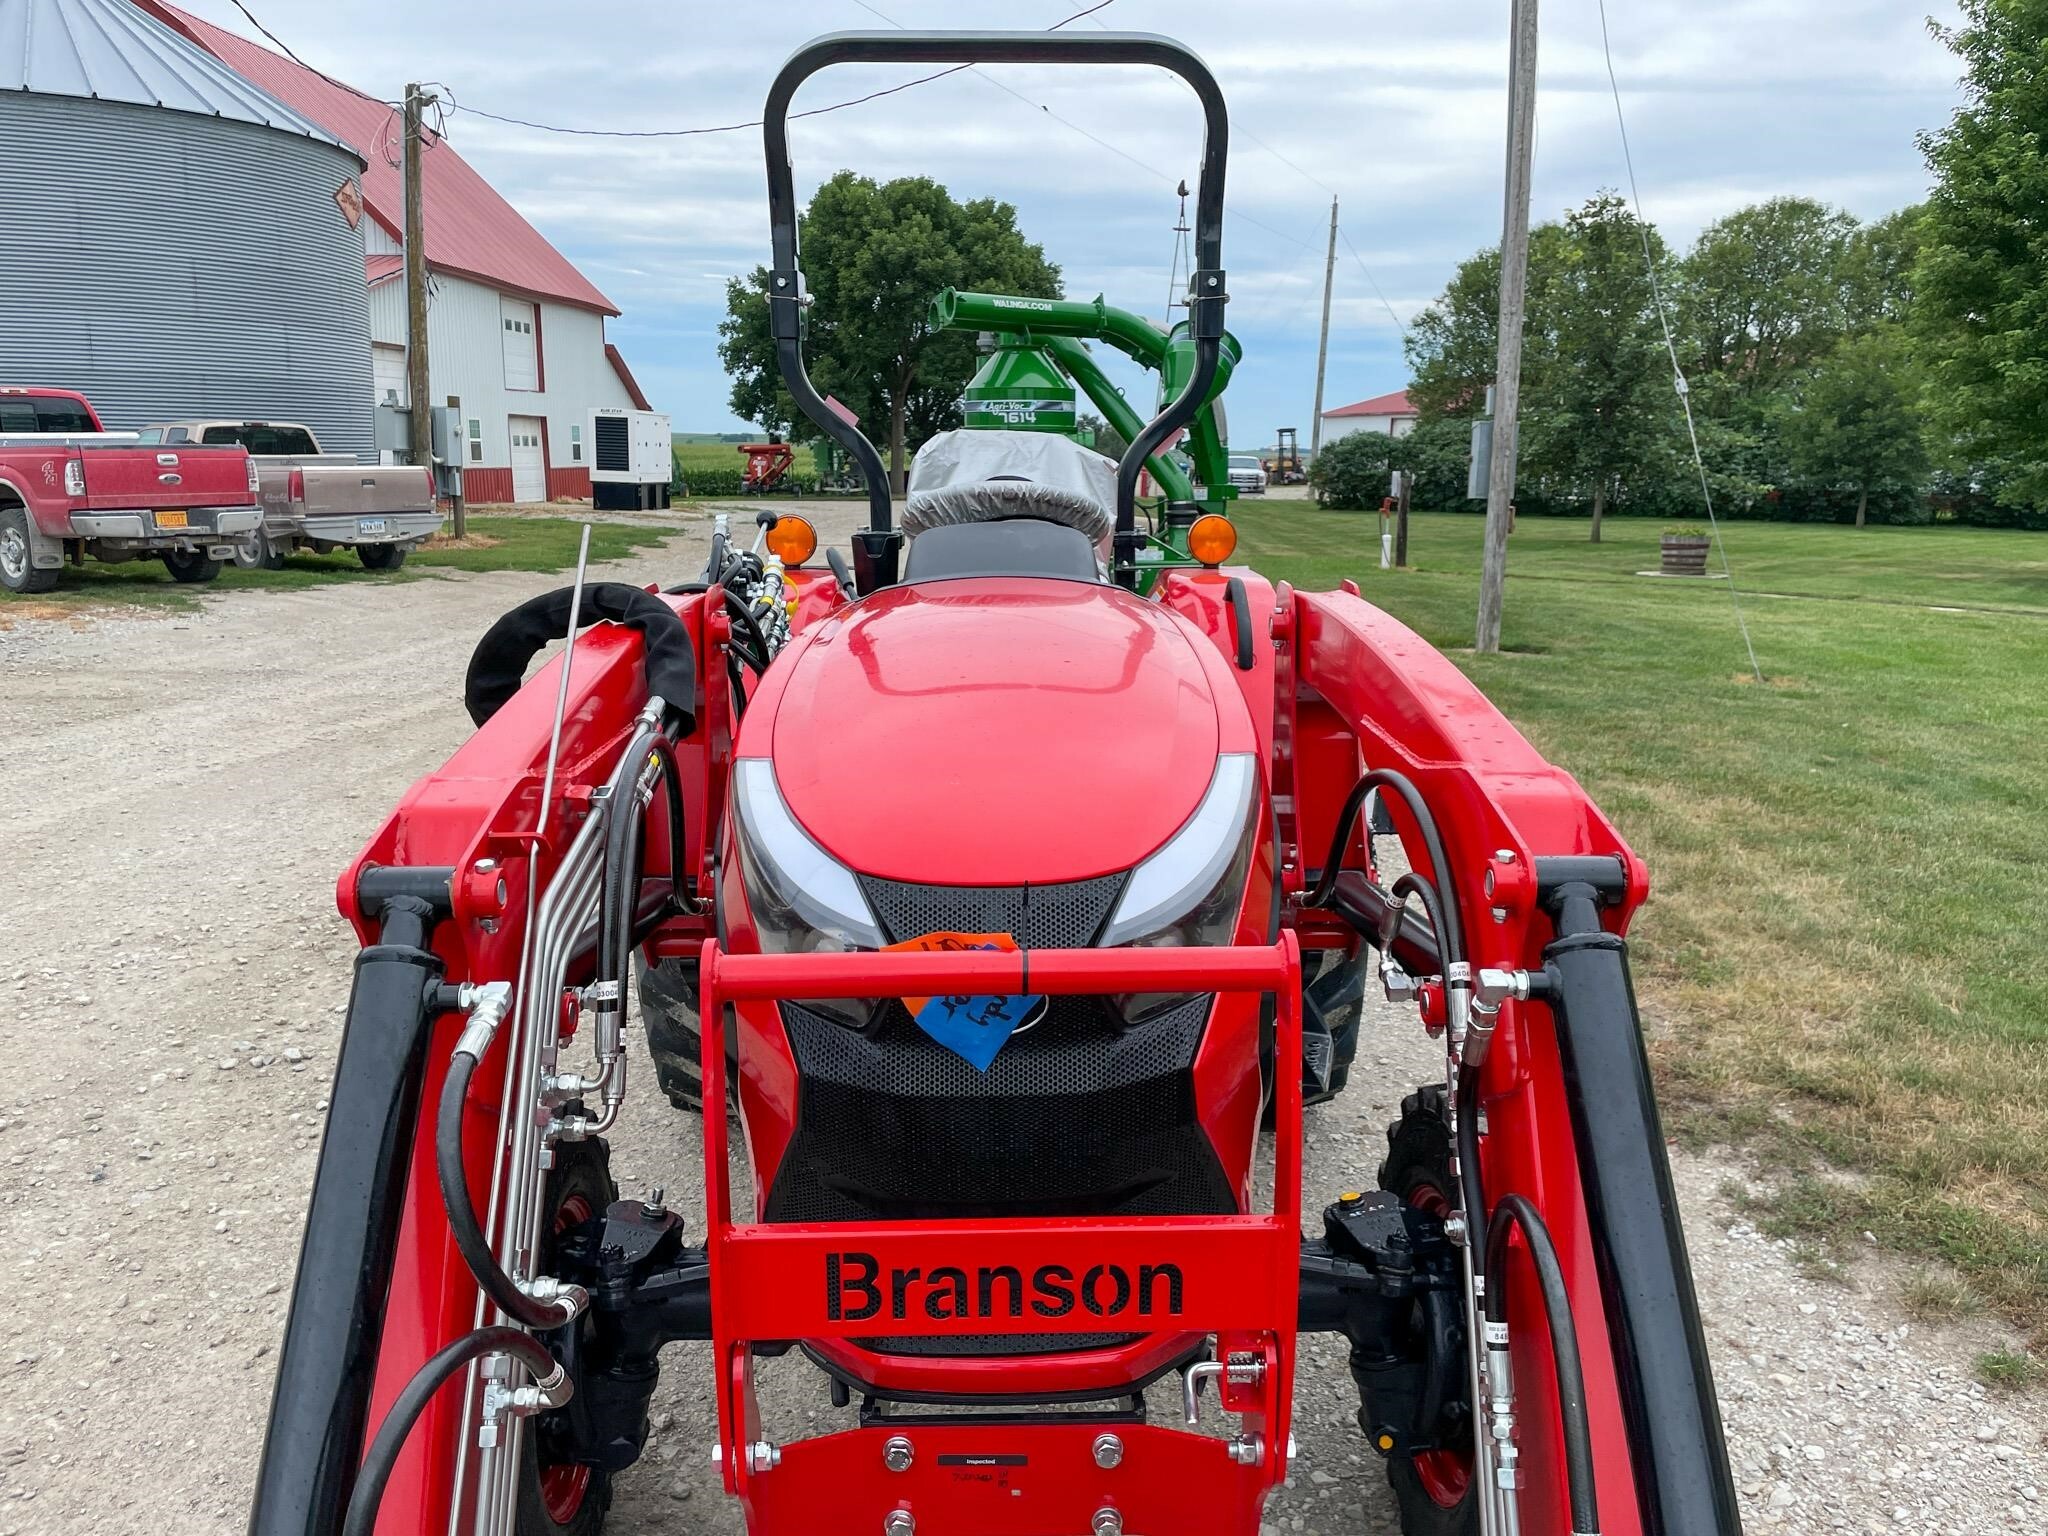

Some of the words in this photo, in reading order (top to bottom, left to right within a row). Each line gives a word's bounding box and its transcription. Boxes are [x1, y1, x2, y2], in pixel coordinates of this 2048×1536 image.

[992, 299, 1053, 312] WALINGA.COM
[998, 411, 1037, 423] 7614
[825, 1251, 1184, 1322] Branson
